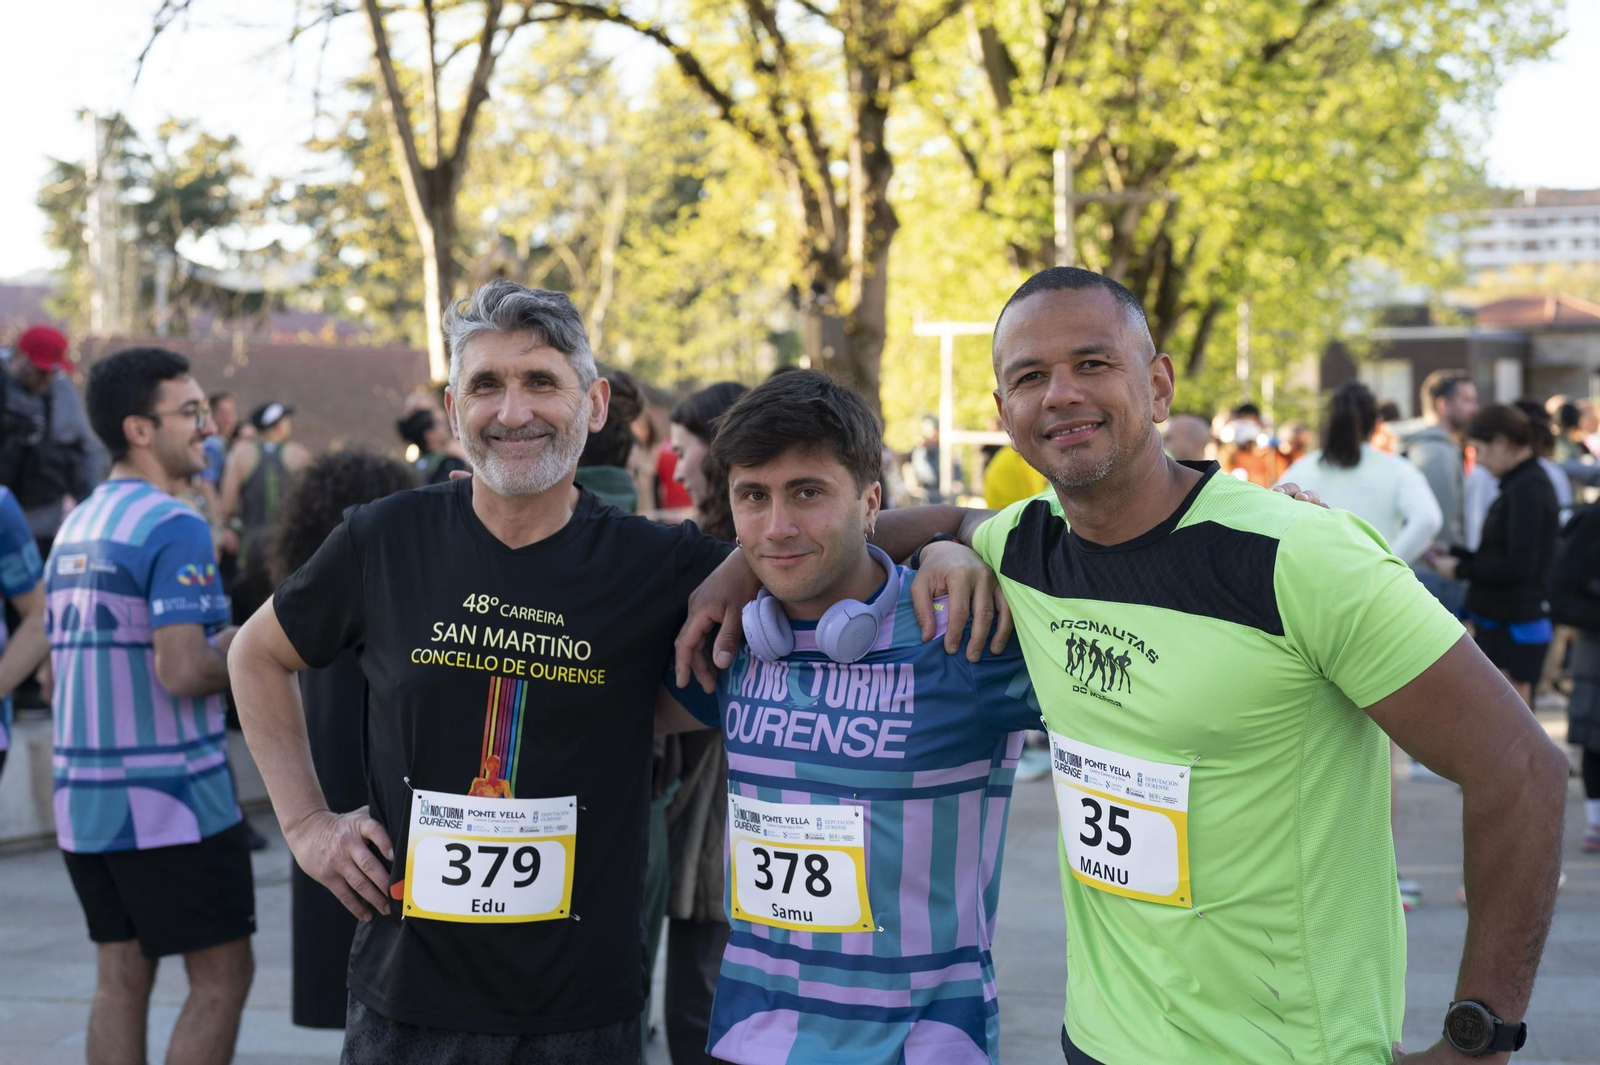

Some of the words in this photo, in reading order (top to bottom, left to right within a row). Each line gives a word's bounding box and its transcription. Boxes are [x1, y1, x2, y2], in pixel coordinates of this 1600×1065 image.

[500, 604, 565, 627] CARREIRA
[431, 621, 477, 645] SAN
[483, 626, 592, 661] MARTIÑO
[411, 648, 499, 671] CONCELLO
[502, 657, 526, 675] DE
[530, 662, 606, 684] OURENSE
[1072, 684, 1088, 695] DO
[725, 700, 913, 759] OURENSE
[1054, 759, 1082, 779] OURENSE
[1084, 758, 1107, 772] PONTE
[1109, 765, 1132, 779] VELLA
[1145, 776, 1179, 787] DEPUTACIÓN
[1145, 782, 1170, 792] OURENSE
[430, 804, 464, 820] NOCTURNA
[468, 809, 496, 819] PONTE
[499, 811, 526, 819] VELLA
[762, 814, 783, 824] PONTE
[785, 816, 810, 825] VELLA
[419, 815, 463, 830] OURENSE
[734, 819, 761, 834] OURENSE
[1079, 797, 1132, 856] 35
[441, 842, 541, 889] 379
[752, 846, 832, 898] 378
[1080, 855, 1129, 885] MANU
[471, 899, 506, 913] Edu
[771, 903, 813, 922] Samu
